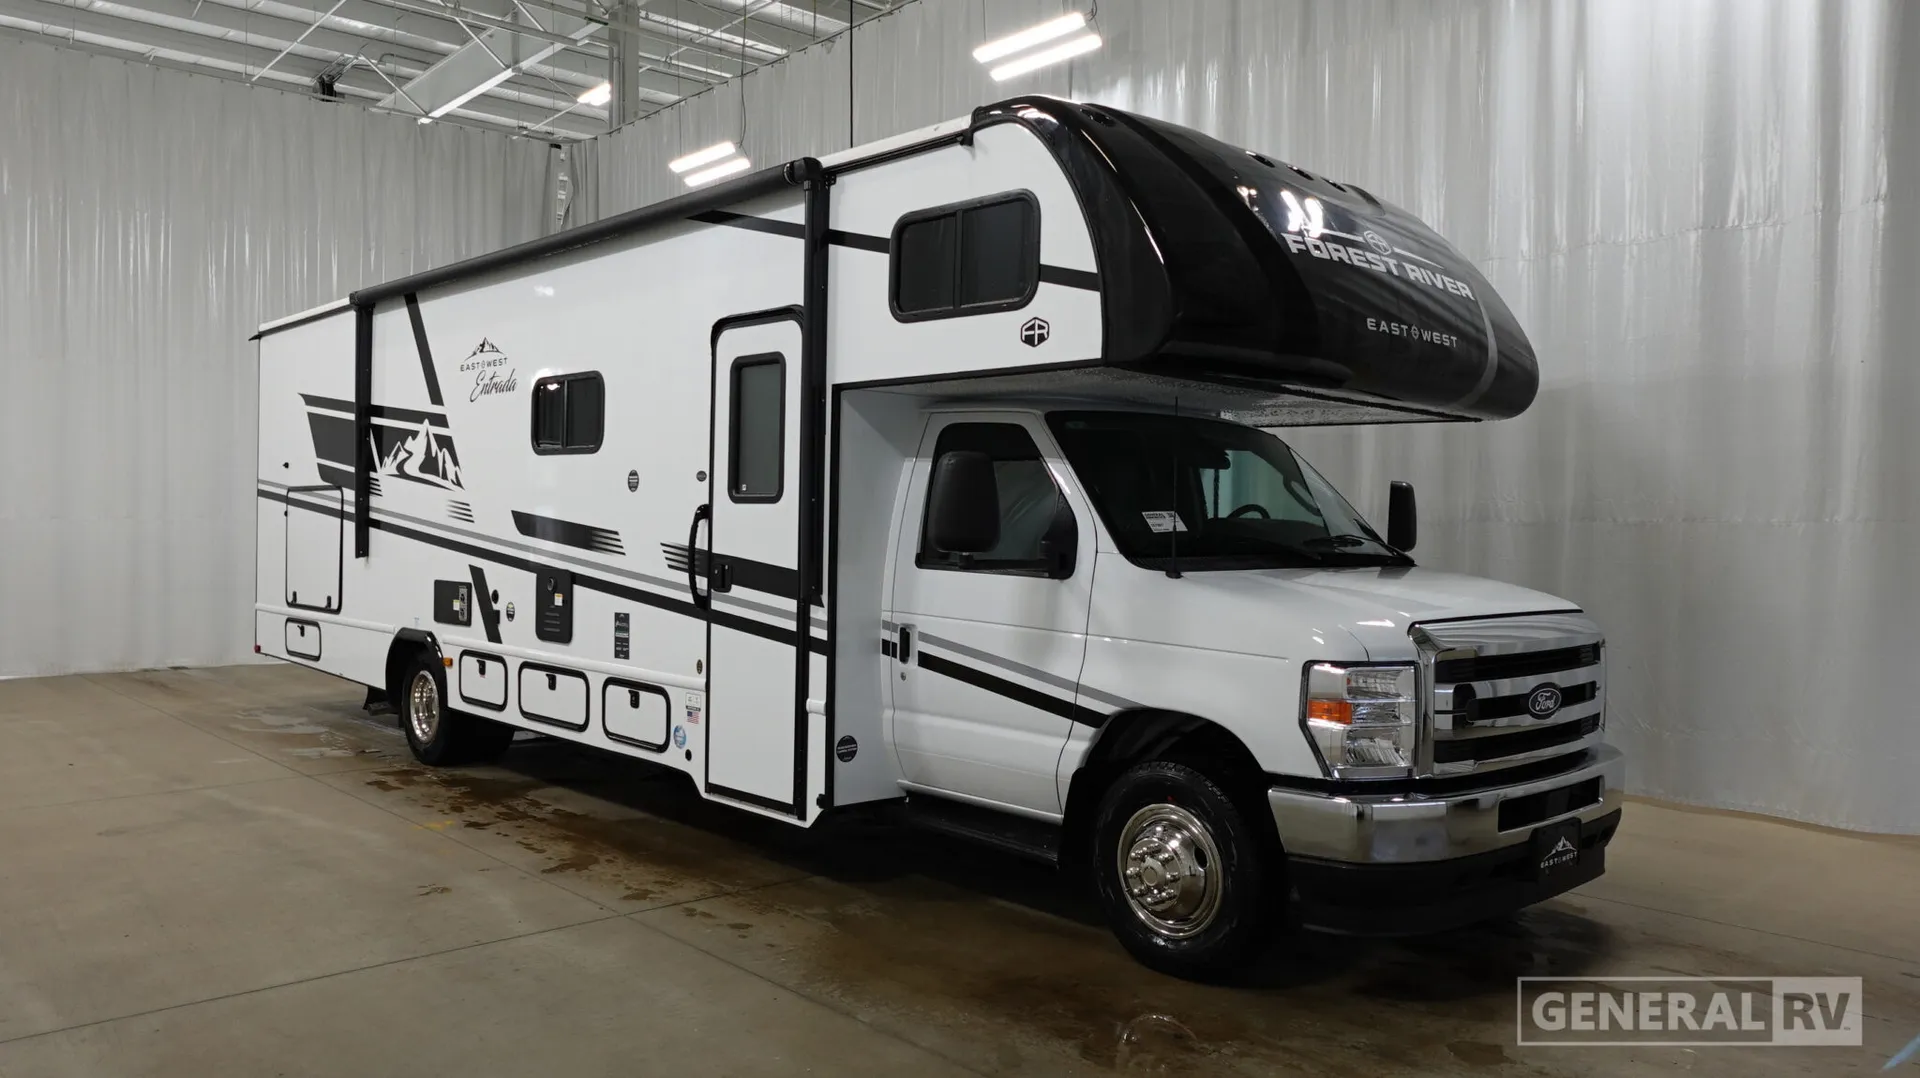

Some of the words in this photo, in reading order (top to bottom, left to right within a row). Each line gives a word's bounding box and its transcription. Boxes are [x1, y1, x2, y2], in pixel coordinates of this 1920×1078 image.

[1281, 232, 1400, 277] FOREST
[1401, 263, 1475, 301] RIVER
[1366, 317, 1409, 340] EAST
[1421, 329, 1458, 348] WEST
[460, 361, 481, 372] EAST
[486, 357, 508, 368] WEST
[470, 368, 517, 402] Entrada
[1535, 692, 1557, 711] Ford
